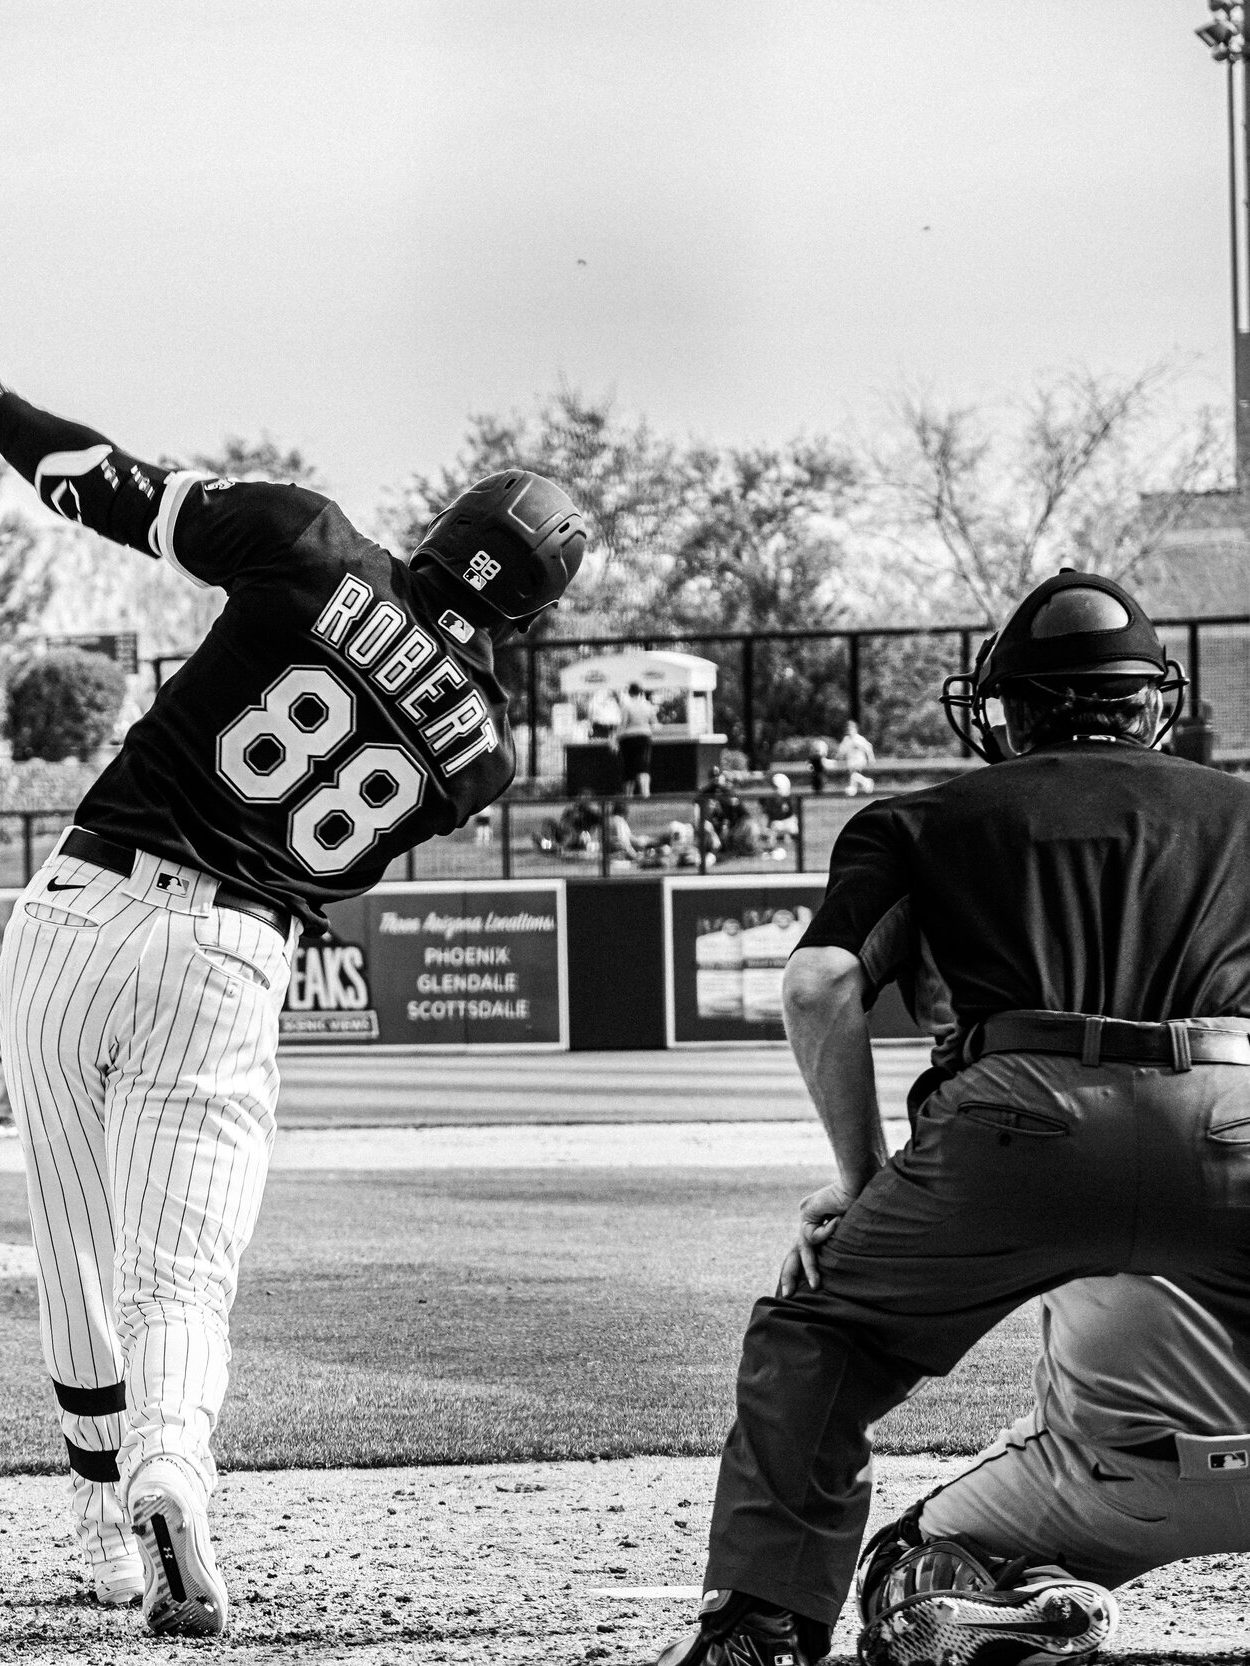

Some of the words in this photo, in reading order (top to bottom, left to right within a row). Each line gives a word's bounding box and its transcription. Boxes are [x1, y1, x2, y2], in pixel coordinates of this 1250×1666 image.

[470, 550, 501, 580] 88
[311, 572, 499, 778] ROBERT
[215, 664, 428, 877] 88
[424, 945, 511, 967] PHOENIX
[290, 946, 368, 1010] EAKS
[417, 972, 519, 994] GLENDALE
[407, 999, 530, 1021] SCOTTSDALE
